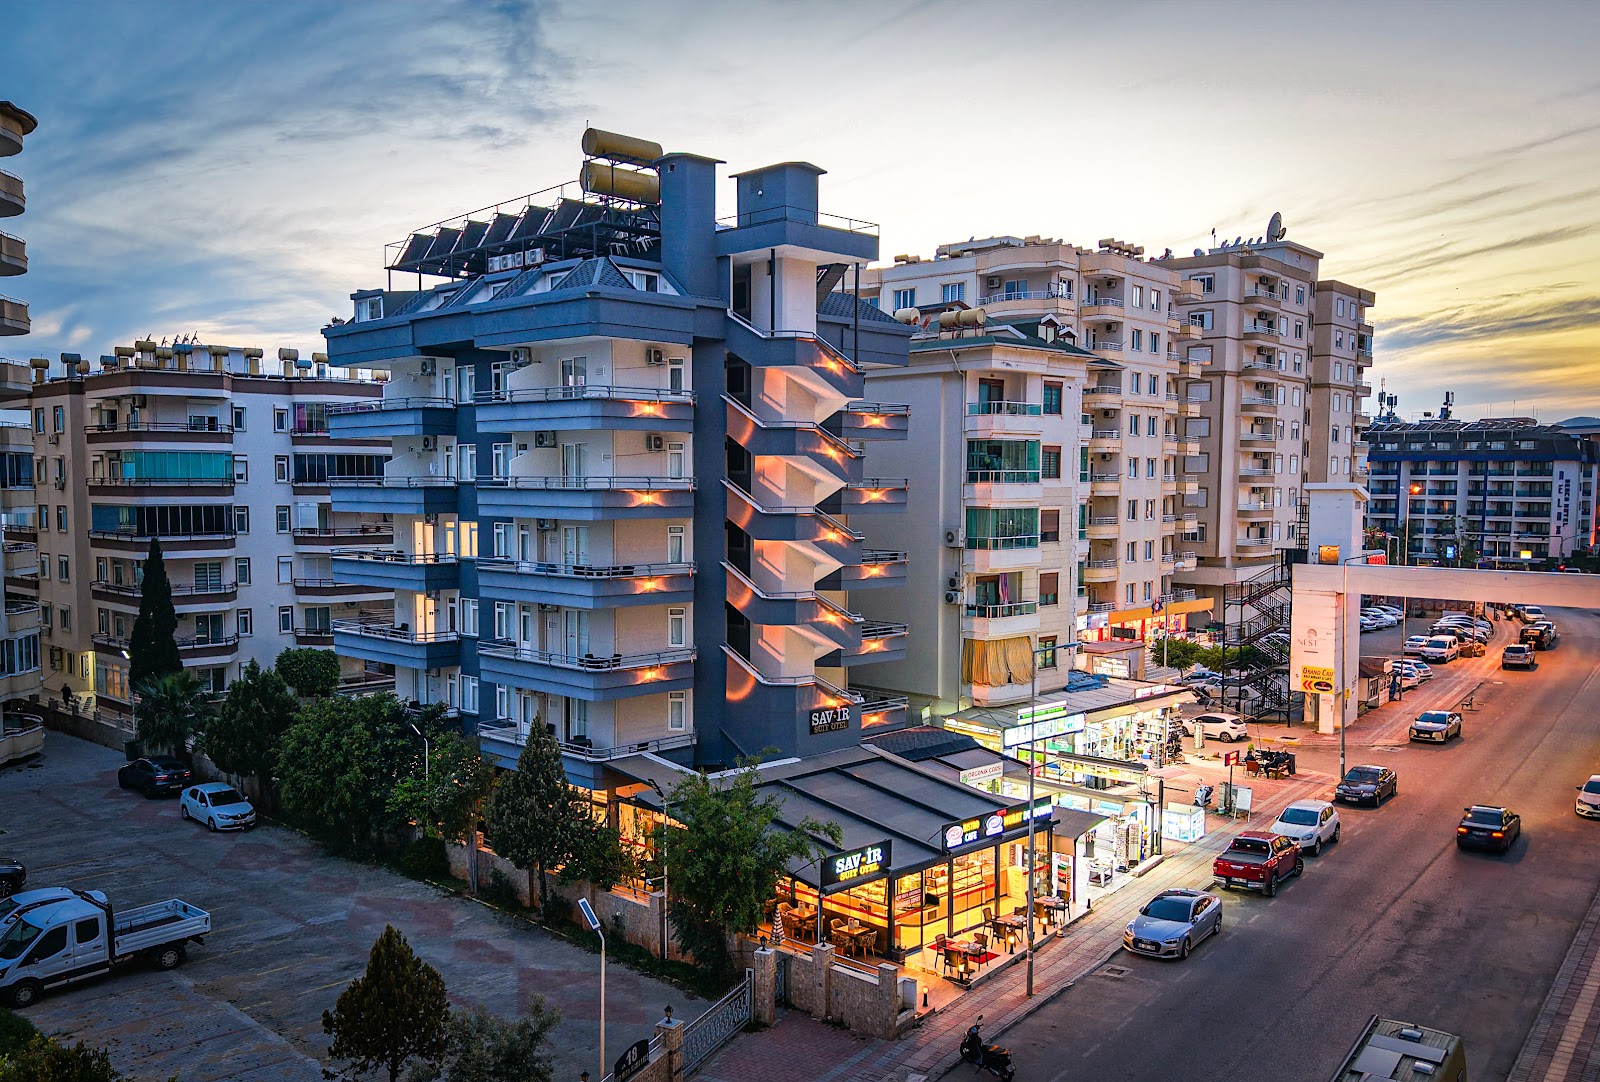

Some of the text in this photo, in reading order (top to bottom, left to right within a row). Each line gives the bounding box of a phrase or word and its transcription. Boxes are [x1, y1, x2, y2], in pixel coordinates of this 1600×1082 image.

[813, 721, 848, 734] SUIT OTEL
[964, 831, 978, 842] CAFE
[839, 862, 880, 881] SUIT OTEL
[626, 1046, 638, 1065] 18
